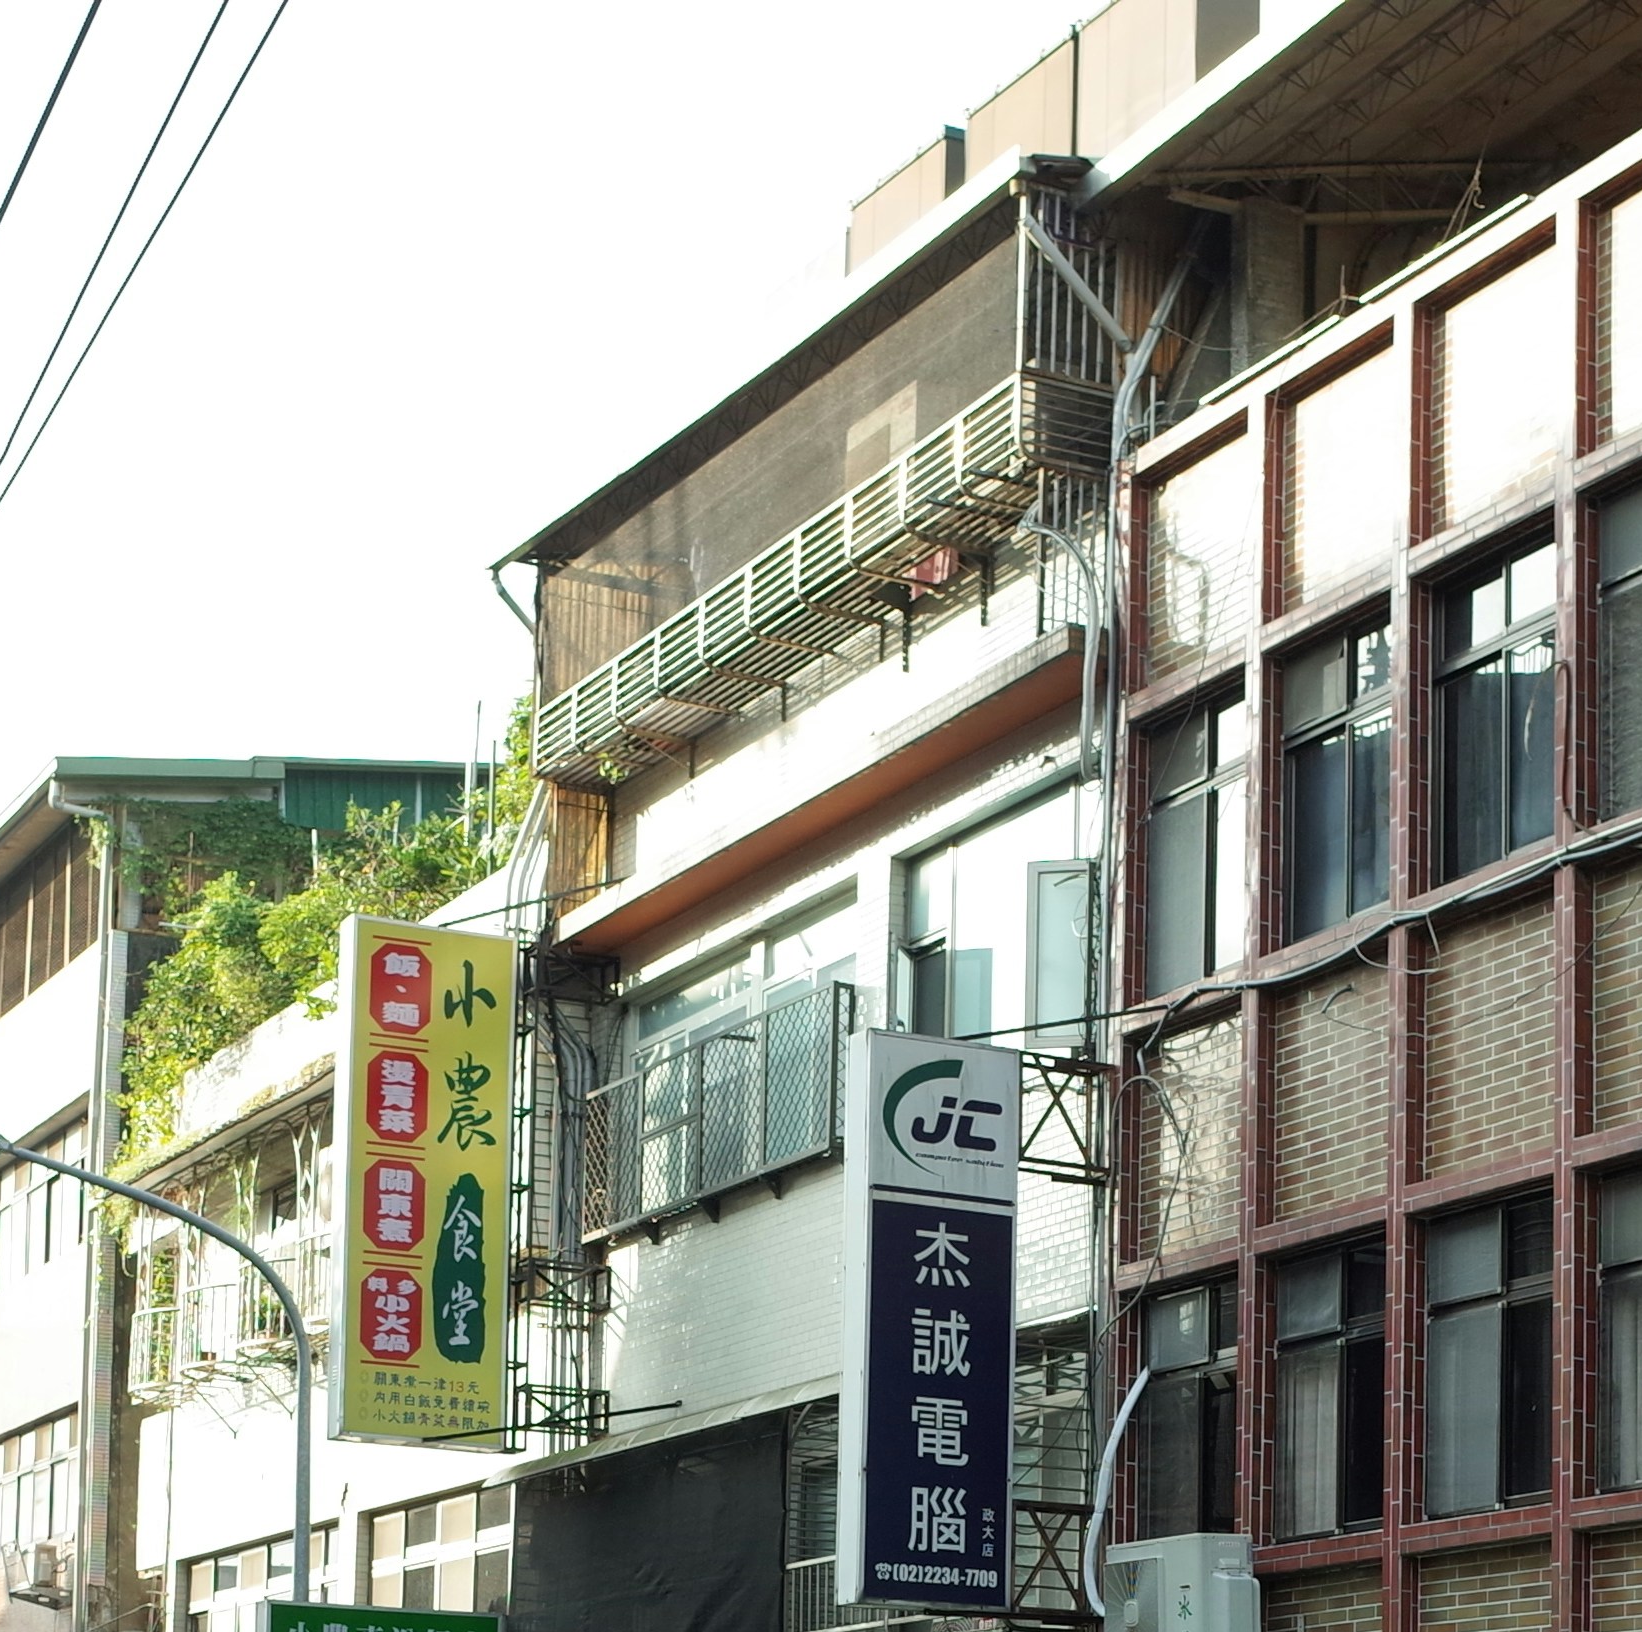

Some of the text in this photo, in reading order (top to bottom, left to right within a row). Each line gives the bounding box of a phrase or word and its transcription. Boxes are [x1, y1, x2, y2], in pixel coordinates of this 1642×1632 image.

[437, 959, 497, 1347] 小農食堂
[907, 1222, 971, 1554] 杰誠電腦
[892, 1562, 999, 1589] (02)2234-7709
[981, 1507, 996, 1558] 政大店
